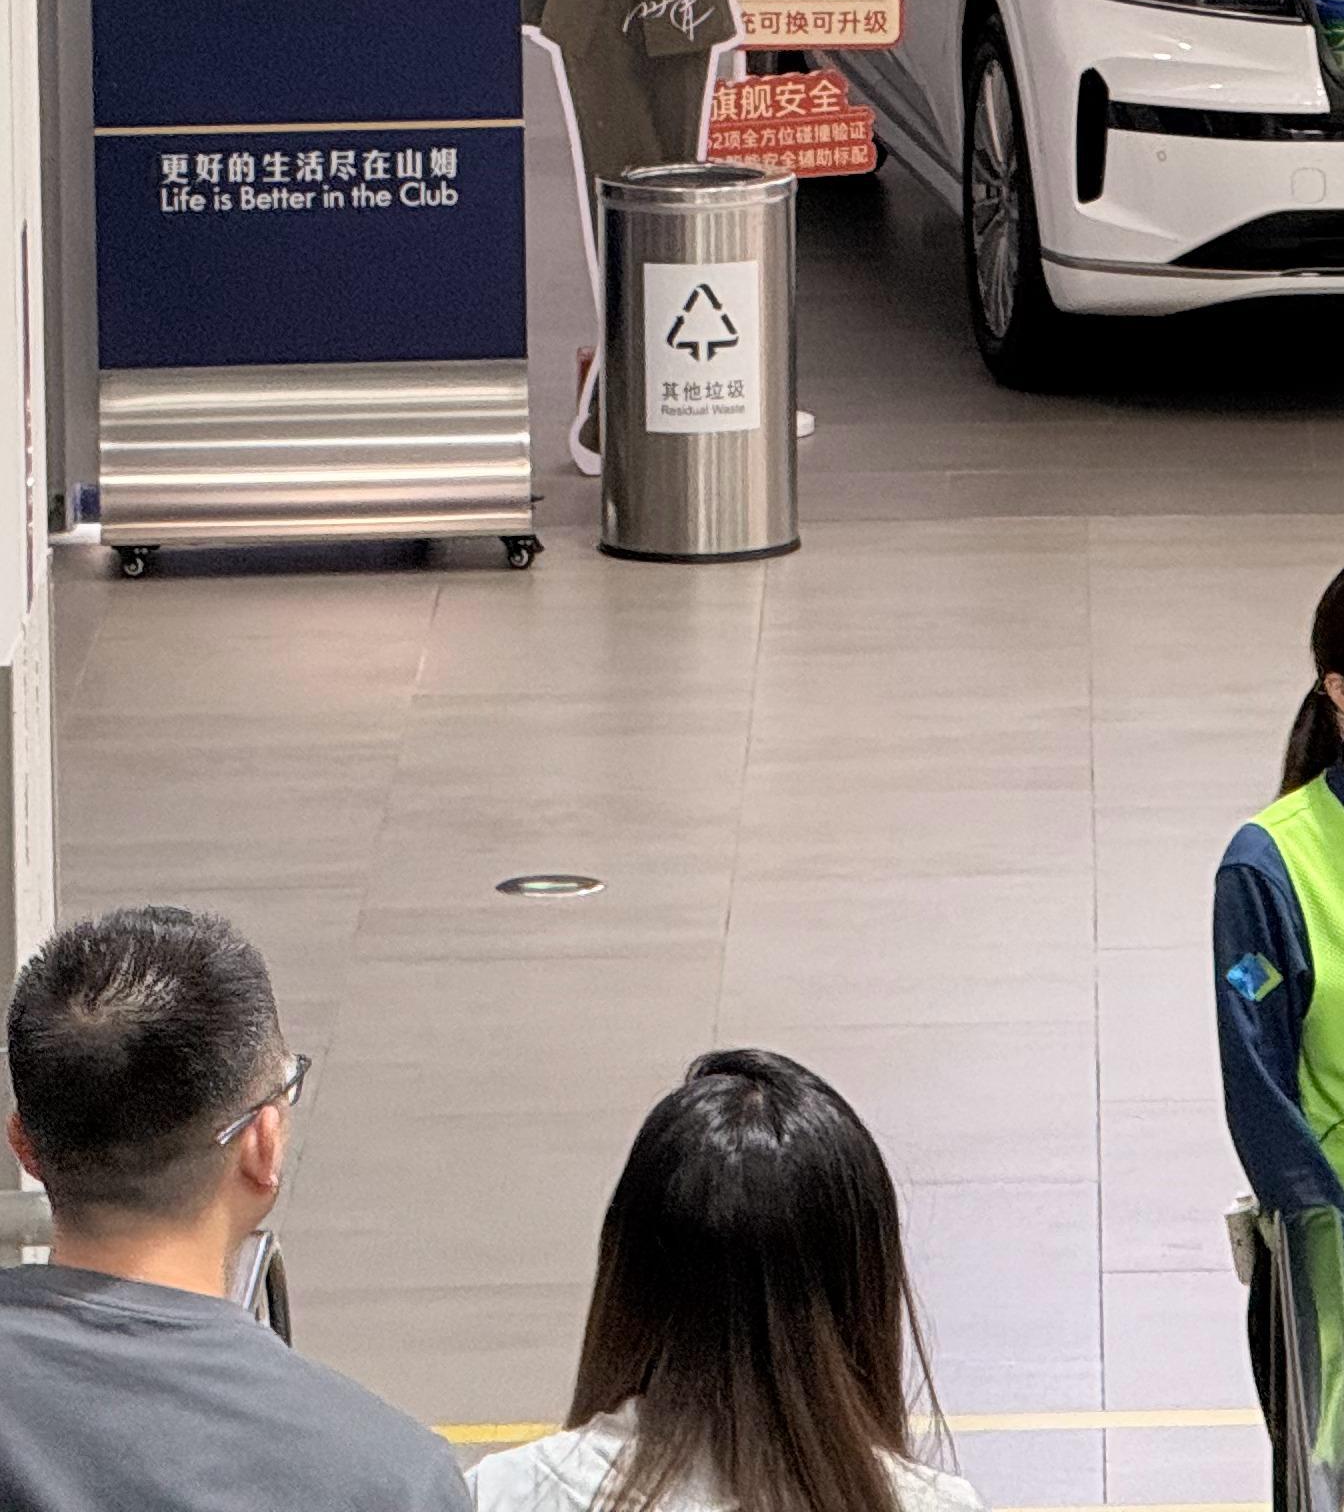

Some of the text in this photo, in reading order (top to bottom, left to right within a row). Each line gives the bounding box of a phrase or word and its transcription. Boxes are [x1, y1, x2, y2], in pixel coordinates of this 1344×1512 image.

[160, 147, 459, 185] 更好的生活尽在山姆
[160, 181, 459, 213] Life is Better in the Club
[662, 379, 746, 402] 其他垃圾
[660, 403, 746, 417] Residual Waste
